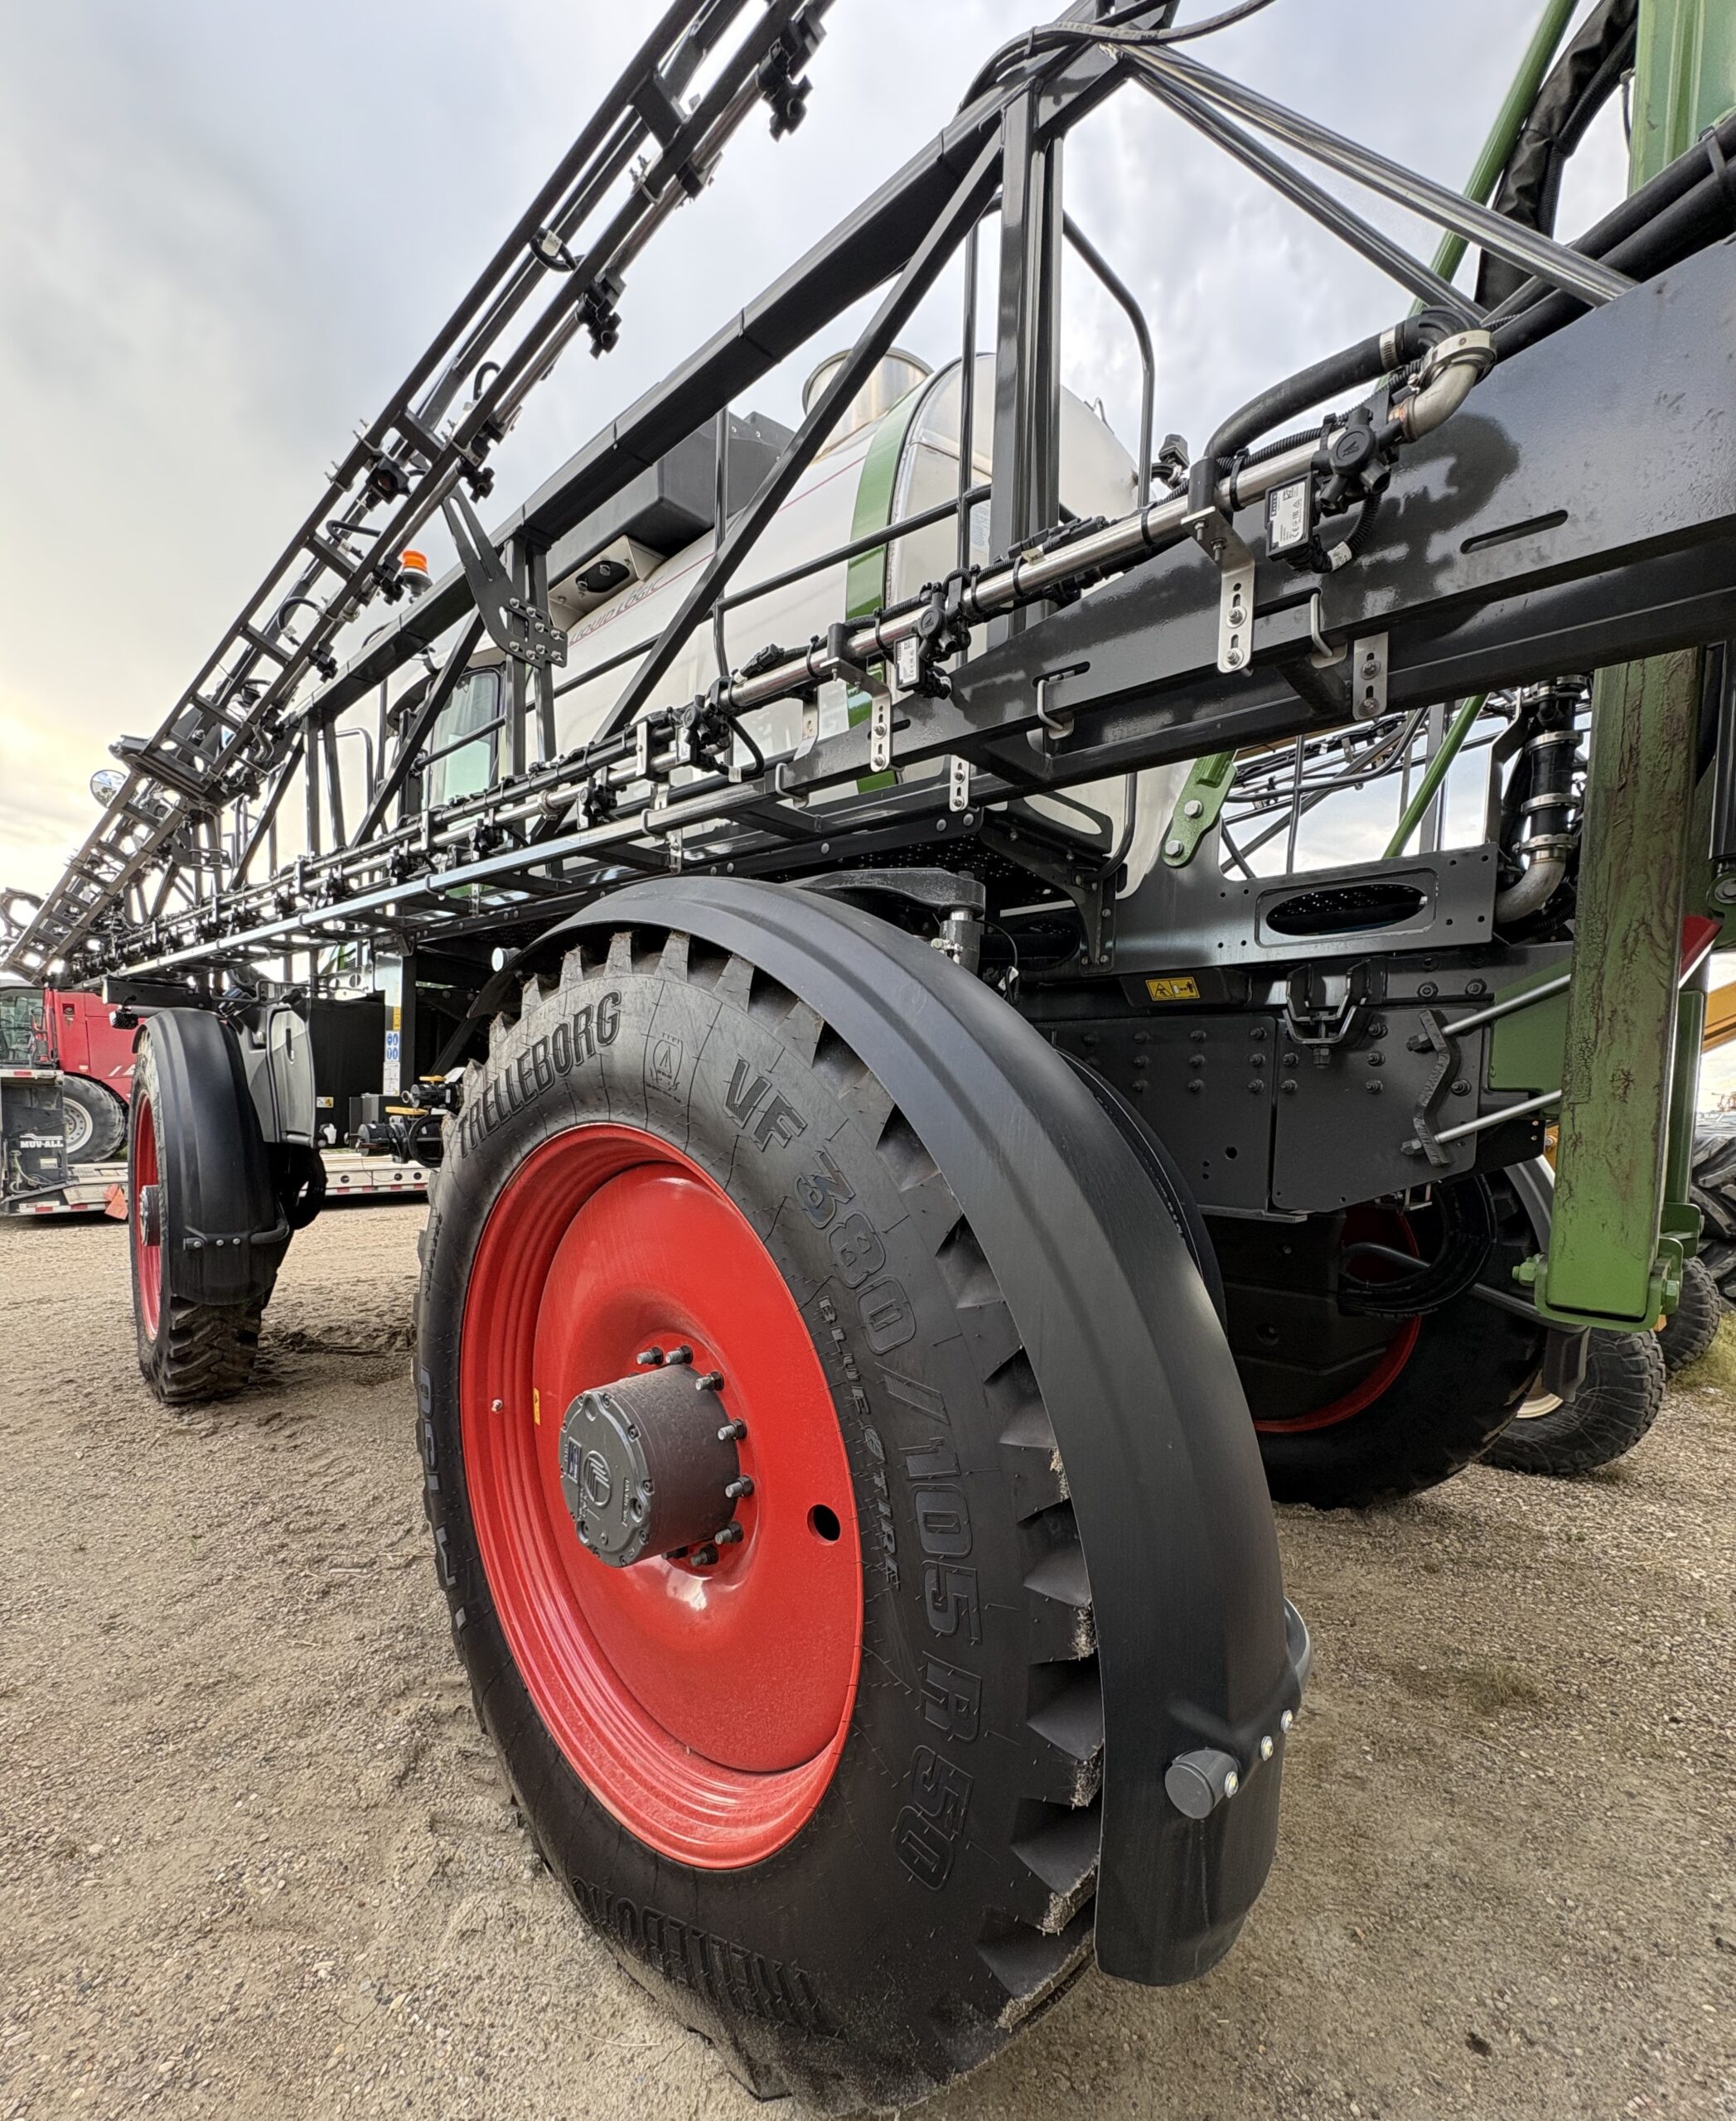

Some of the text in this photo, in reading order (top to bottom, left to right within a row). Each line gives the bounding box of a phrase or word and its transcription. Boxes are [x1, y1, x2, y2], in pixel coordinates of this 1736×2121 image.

[569, 577, 664, 645] LIQUID LOGIC
[458, 989, 621, 1158] TRELLEBORG
[723, 1058, 809, 1152] VF
